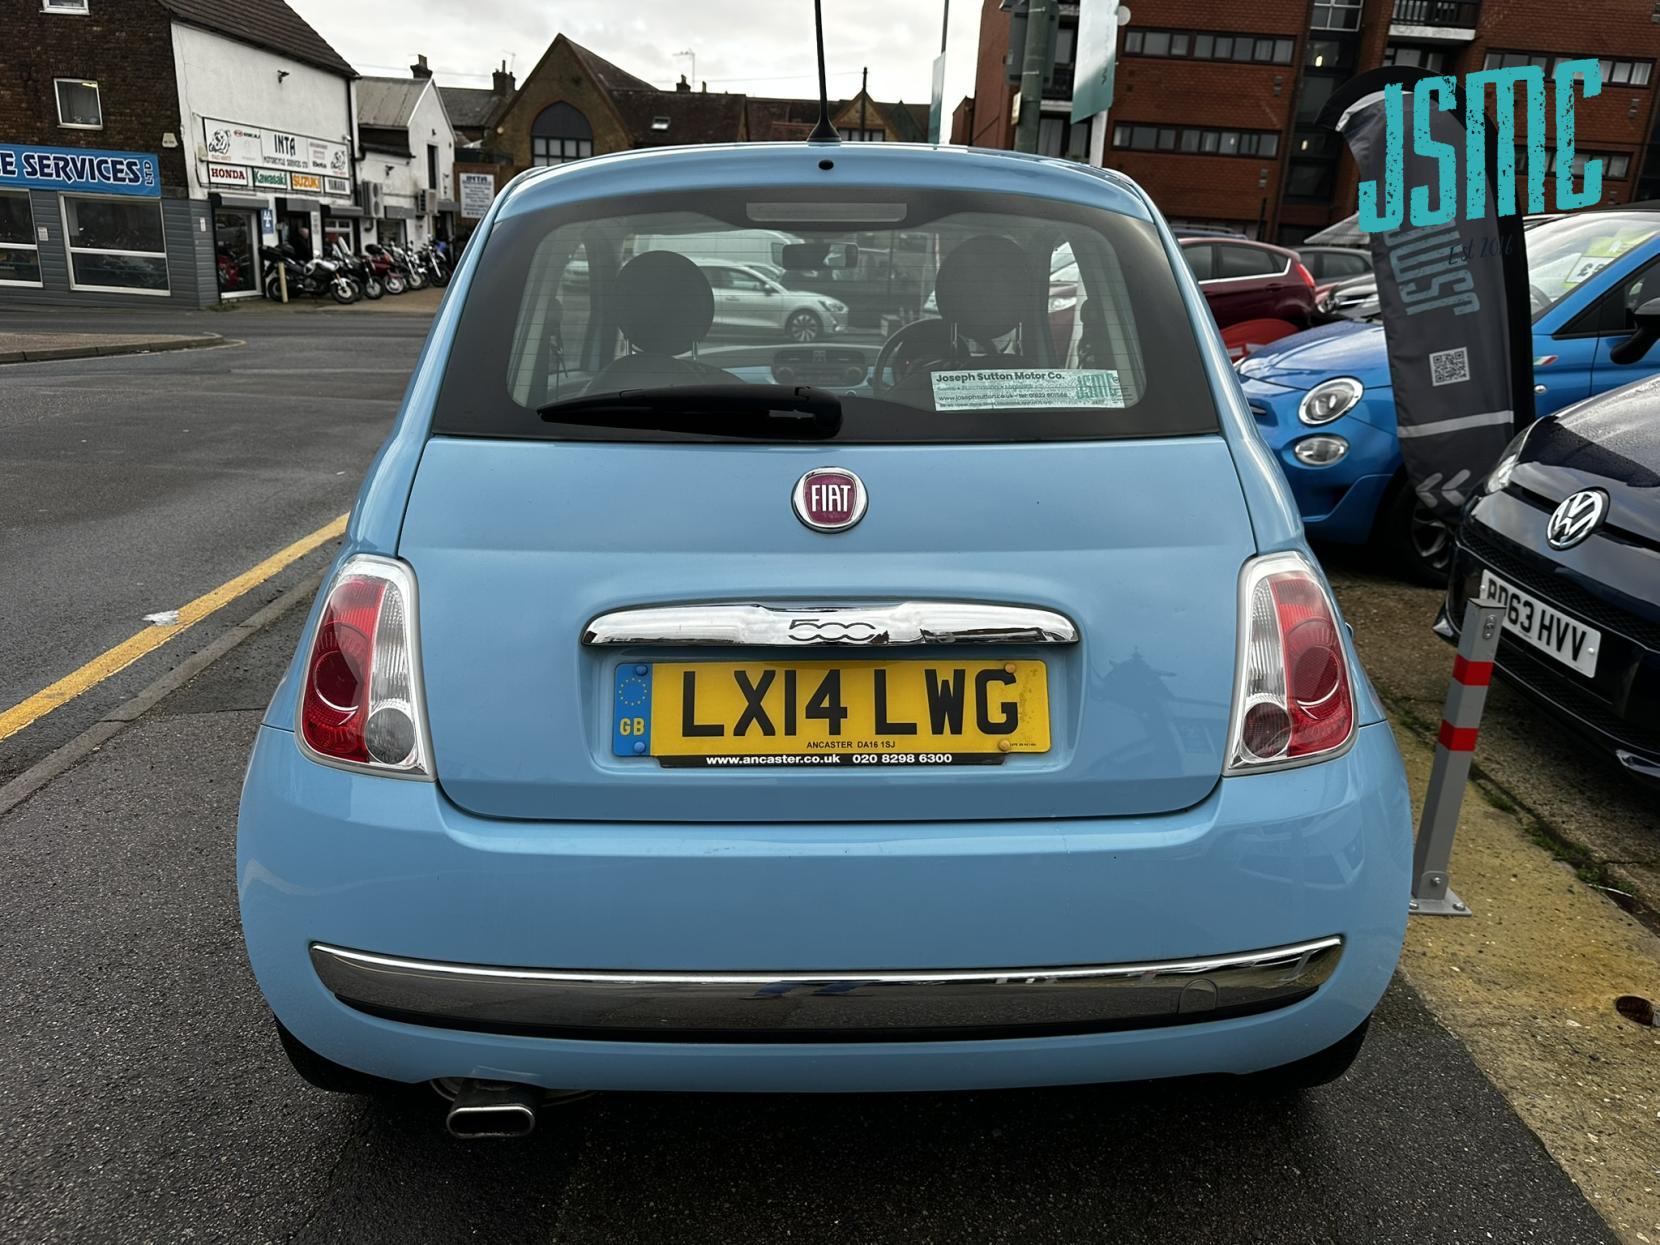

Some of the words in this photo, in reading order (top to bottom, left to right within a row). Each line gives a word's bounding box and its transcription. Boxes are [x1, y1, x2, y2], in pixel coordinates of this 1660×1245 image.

[274, 134, 296, 157] INTA
[22, 152, 142, 184] SERVICES
[143, 160, 154, 186] LTD
[211, 168, 245, 180] HONDA
[254, 170, 287, 186] Kawasaki
[292, 174, 320, 189] SUZUKI
[936, 373, 976, 383] Joseph
[977, 372, 1013, 381] Sutton
[1014, 371, 1046, 380] Motor
[1048, 371, 1065, 380] Co.
[811, 485, 851, 512] FIAT
[788, 619, 876, 641] 500
[1538, 609, 1587, 662] HVV
[681, 669, 848, 738] LX14
[874, 668, 1019, 736] LWG
[620, 717, 645, 736] GB
[806, 741, 853, 749] ANCASTER
[857, 741, 878, 749] DA16
[881, 741, 896, 749] 1SJ
[706, 754, 840, 765] www.ancaster.co.uk
[852, 754, 877, 764] 020
[881, 754, 915, 764] 8298
[919, 754, 952, 764] 6300
